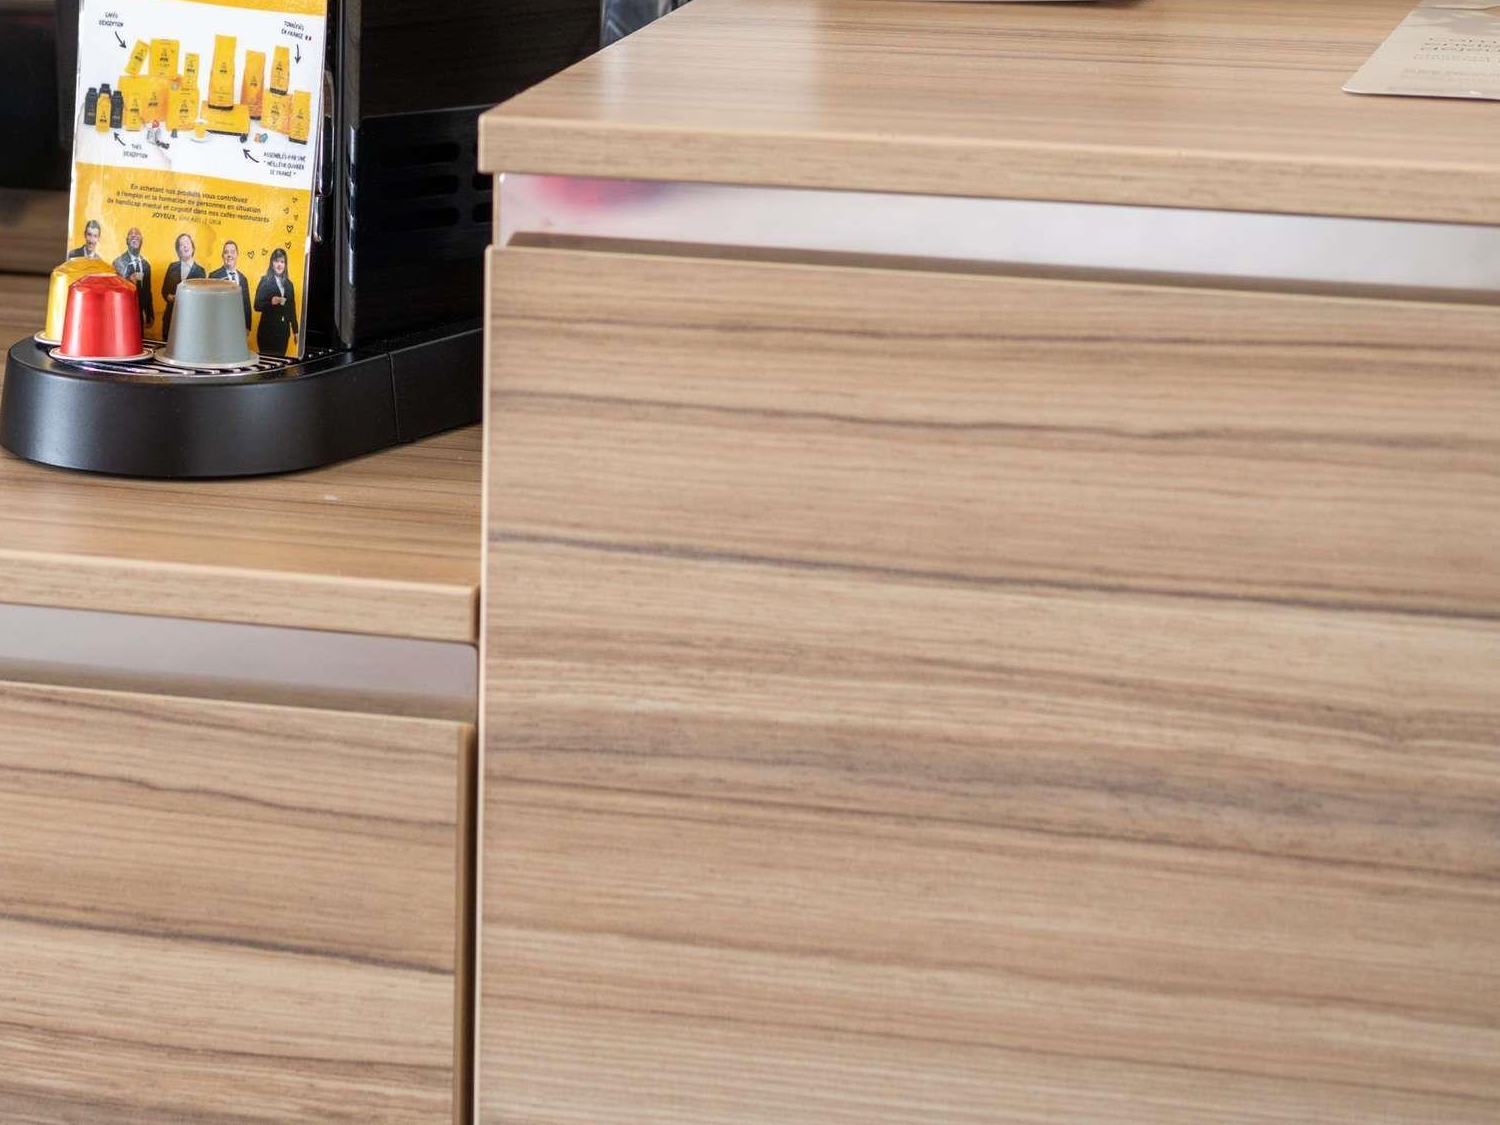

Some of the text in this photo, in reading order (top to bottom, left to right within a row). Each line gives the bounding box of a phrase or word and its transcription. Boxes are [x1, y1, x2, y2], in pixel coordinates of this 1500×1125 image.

[140, 185, 164, 193] achetant
[216, 194, 248, 204] contribuez
[115, 198, 141, 207] handicap
[158, 195, 186, 204] formation
[196, 200, 226, 209] personnes
[236, 205, 261, 214] situation
[152, 211, 177, 221] JOYEUX,
